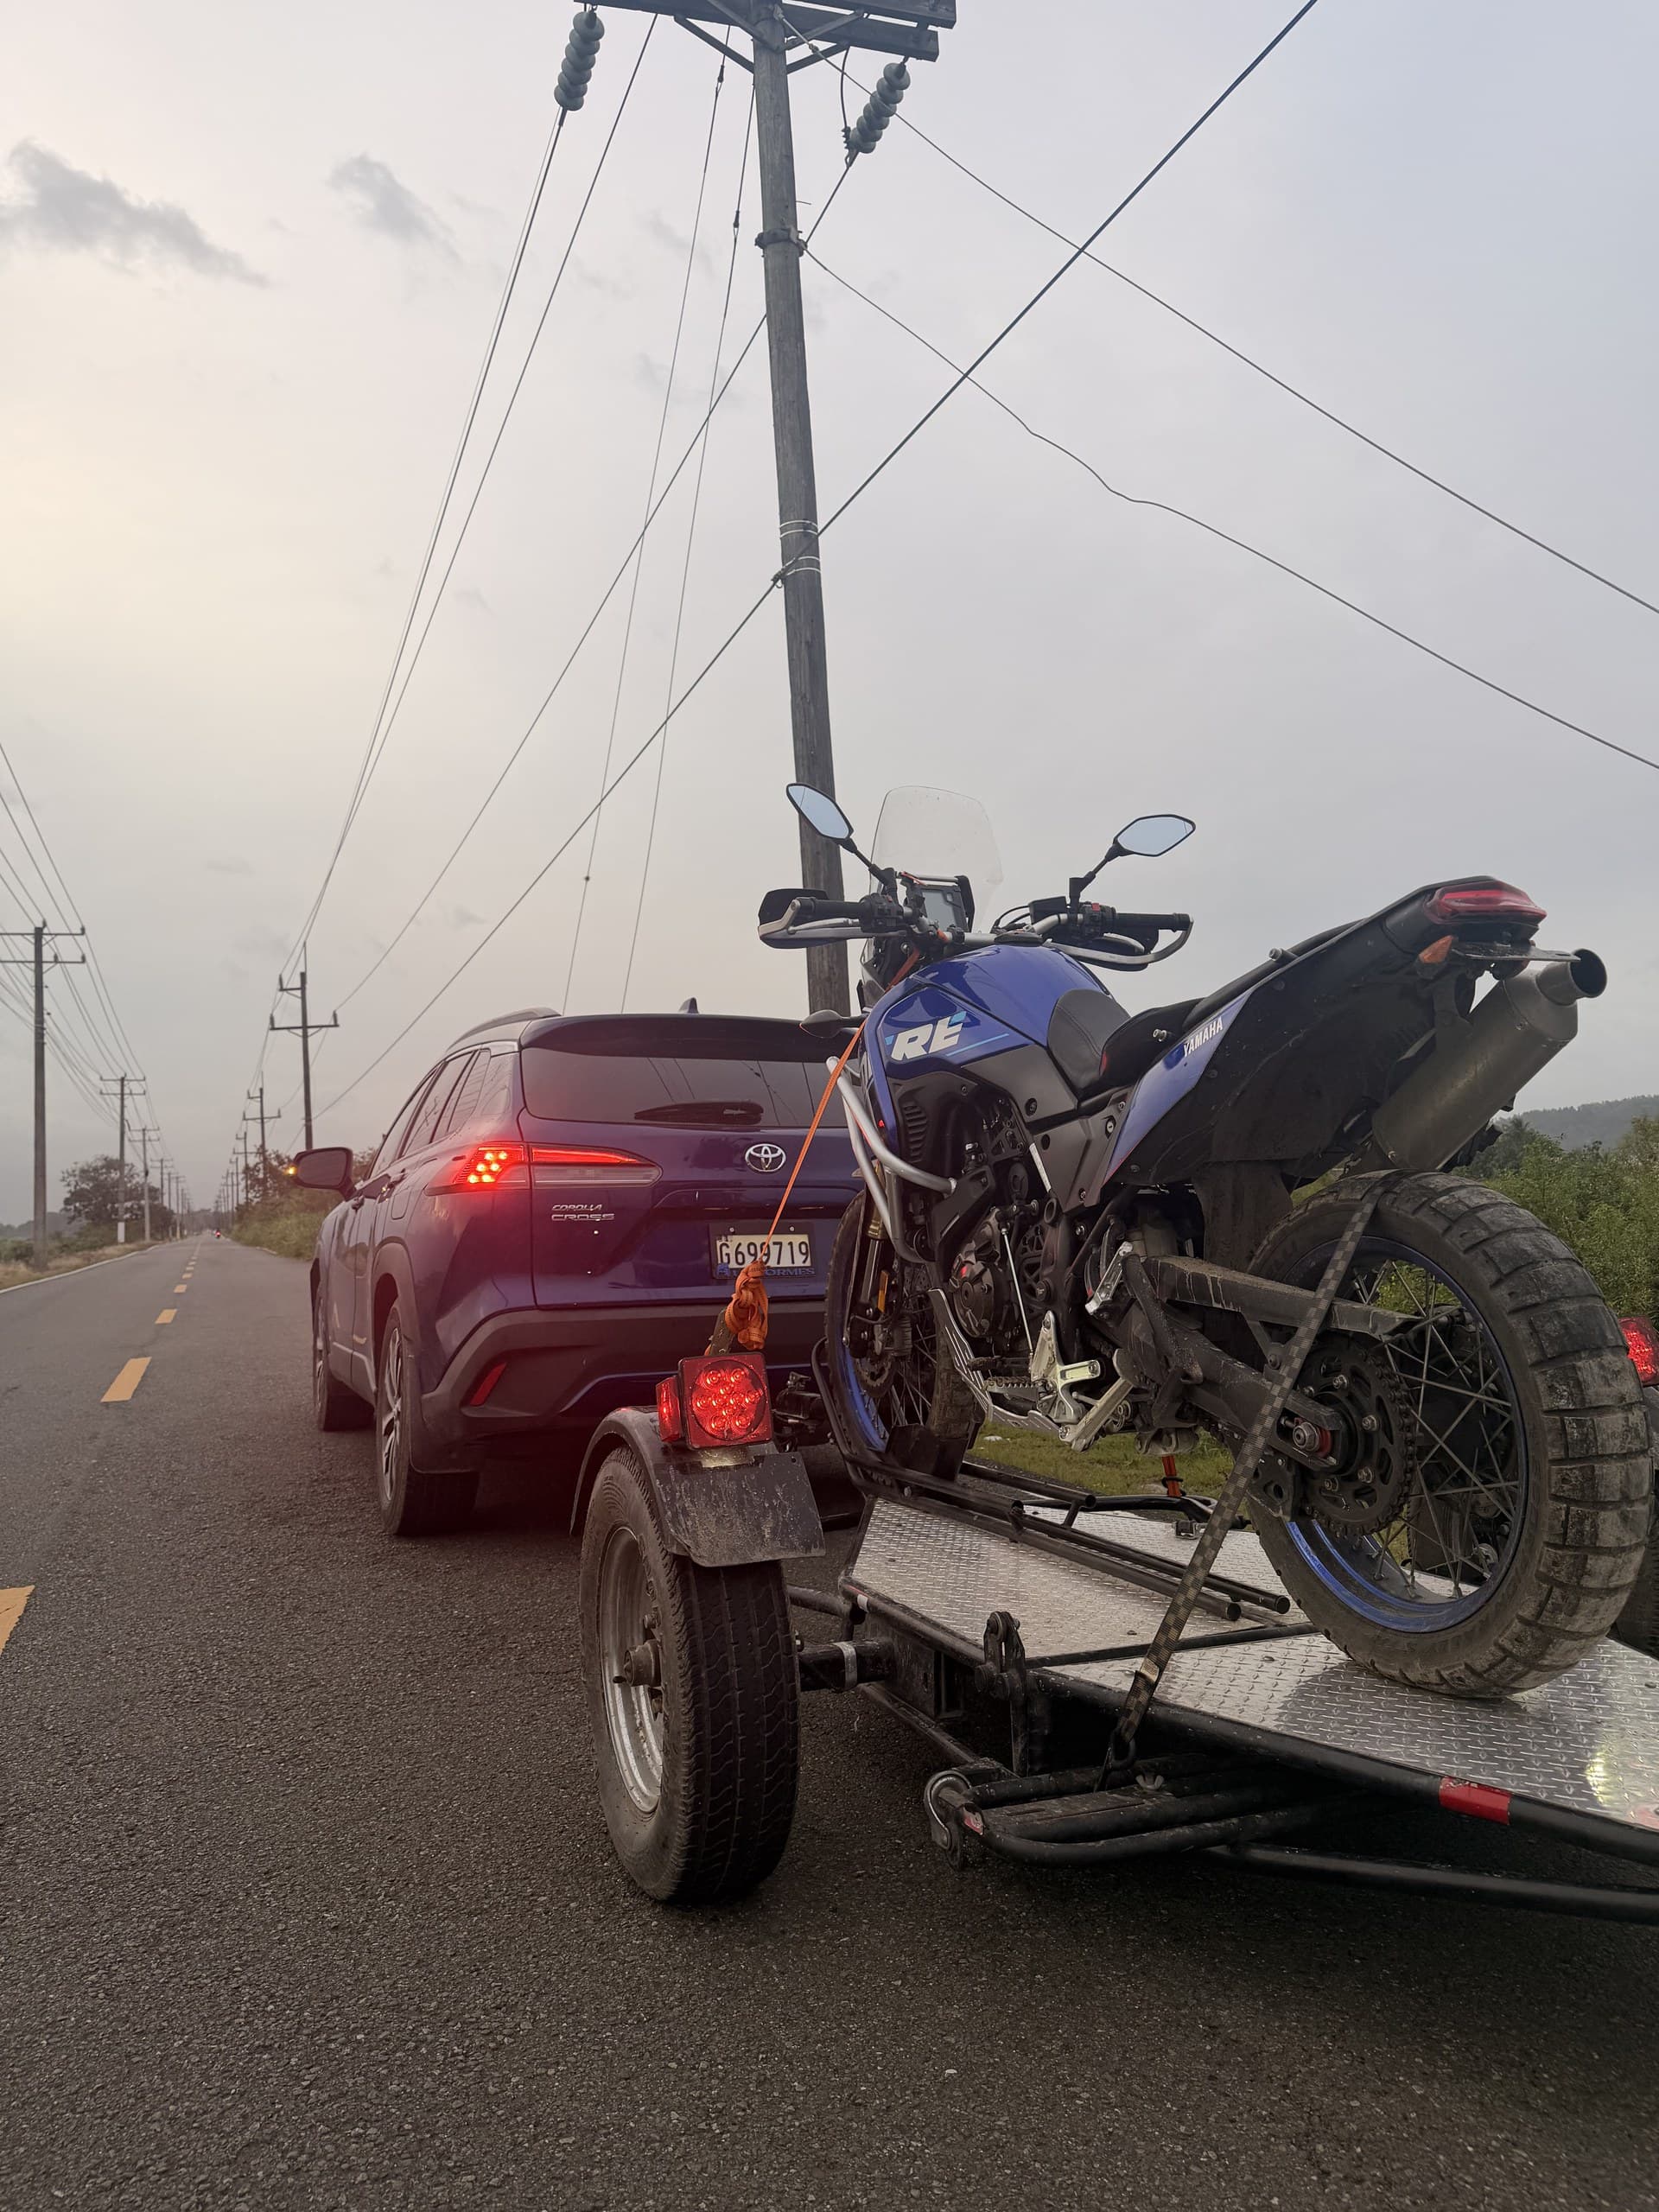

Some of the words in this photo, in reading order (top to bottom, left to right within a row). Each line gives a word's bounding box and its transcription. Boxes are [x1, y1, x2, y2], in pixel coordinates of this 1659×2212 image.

[1183, 1015, 1224, 1058] YAMAHA
[551, 1213, 615, 1222] CROSS
[719, 1241, 810, 1266] G699719
